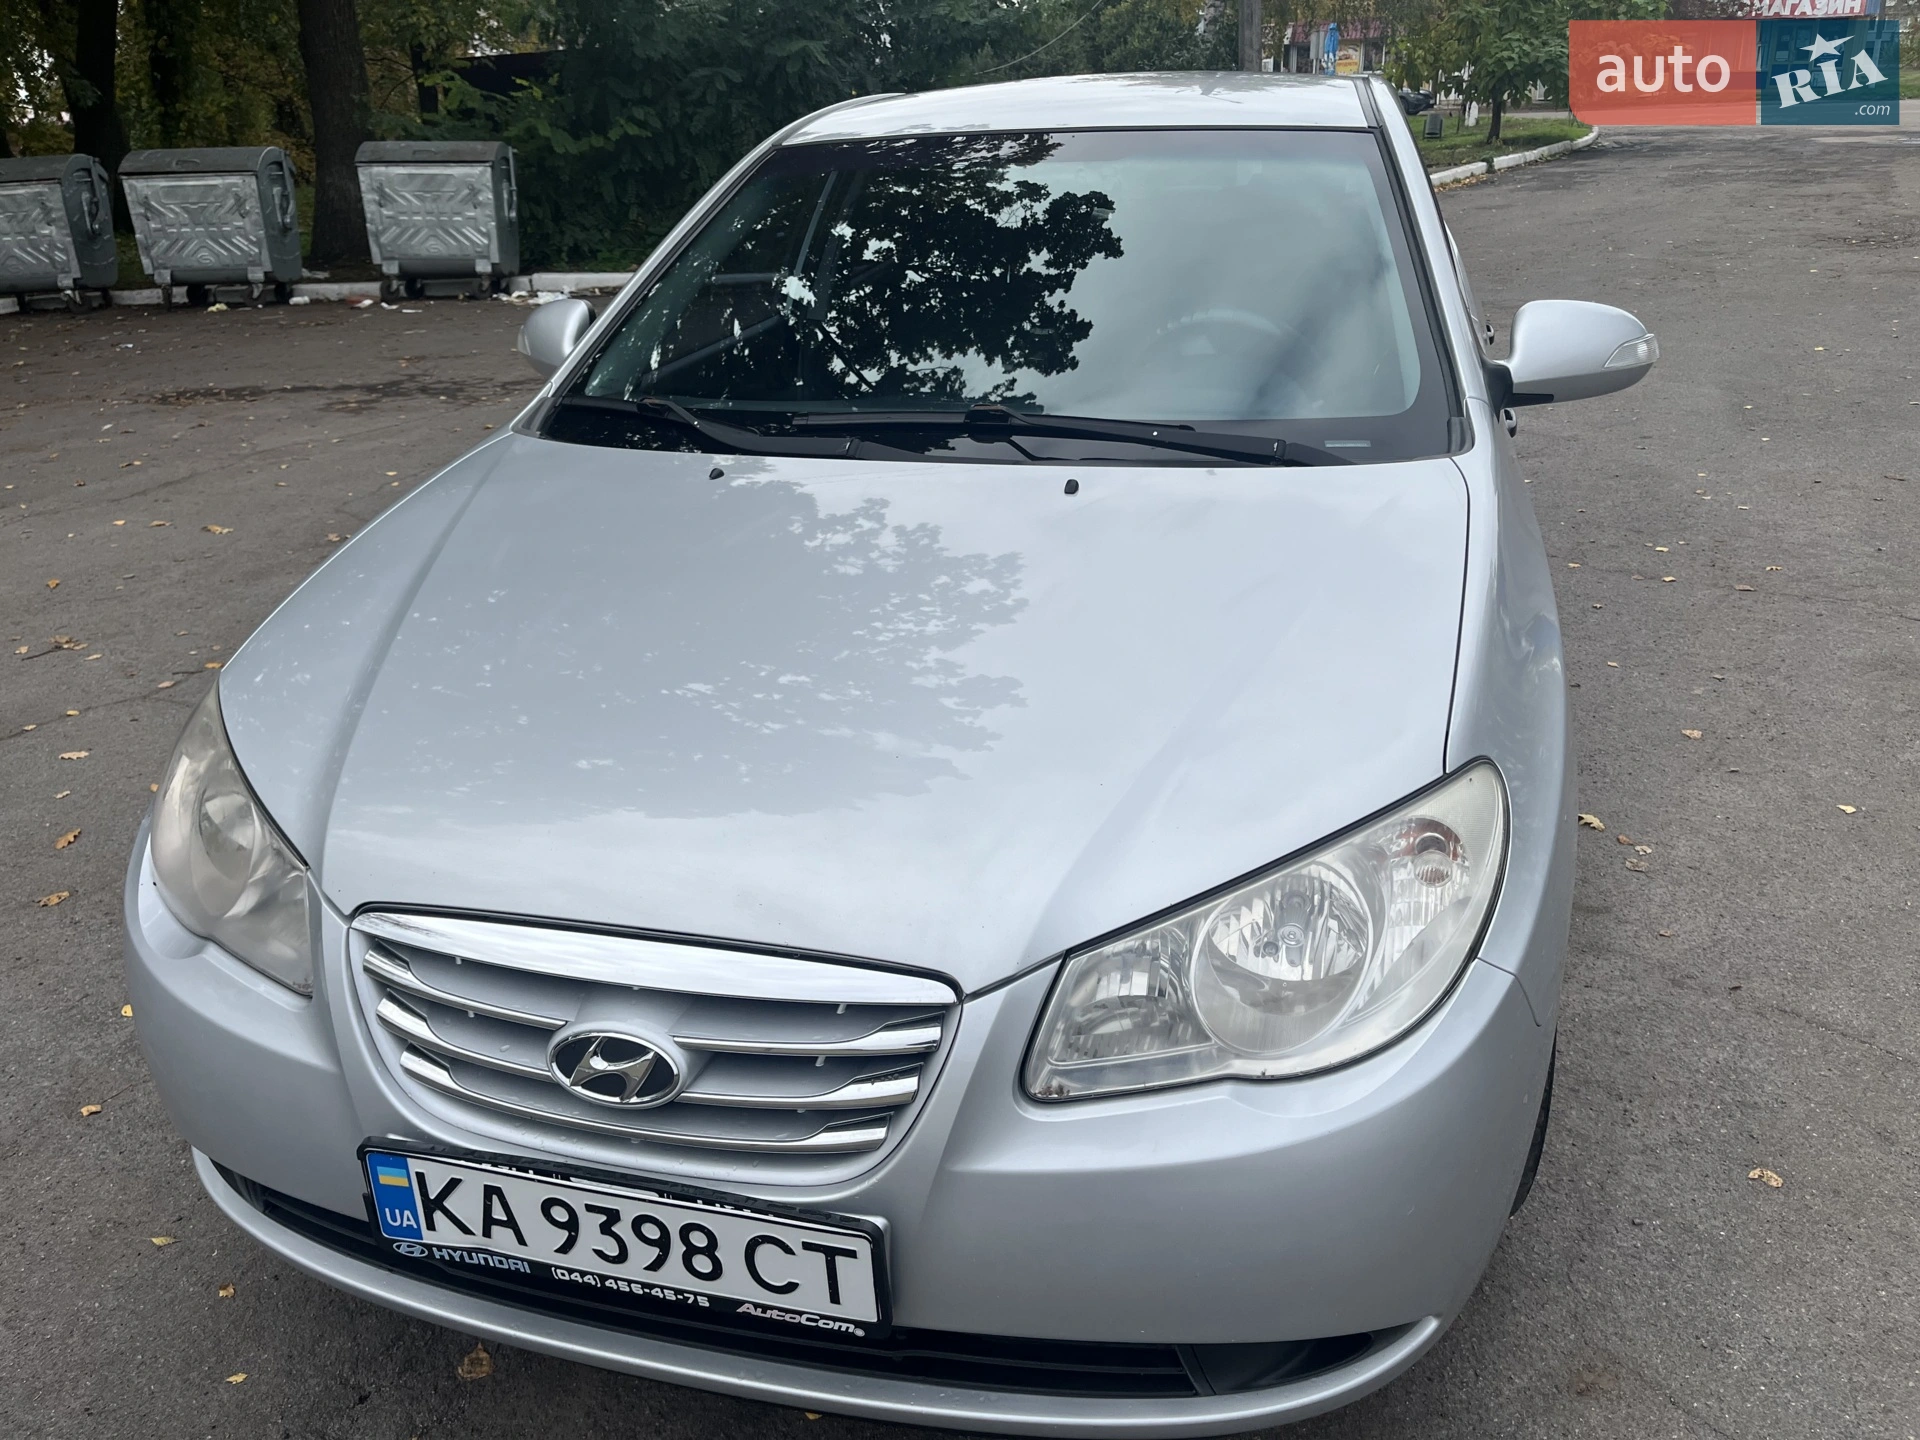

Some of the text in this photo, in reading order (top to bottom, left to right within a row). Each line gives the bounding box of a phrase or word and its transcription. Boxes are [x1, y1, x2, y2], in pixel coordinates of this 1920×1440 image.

[384, 1207, 418, 1229] UA
[415, 1171, 858, 1306] KA 9398 CT
[432, 1246, 531, 1274] HYUNDAI
[551, 1266, 710, 1308] (044) 456-45-75
